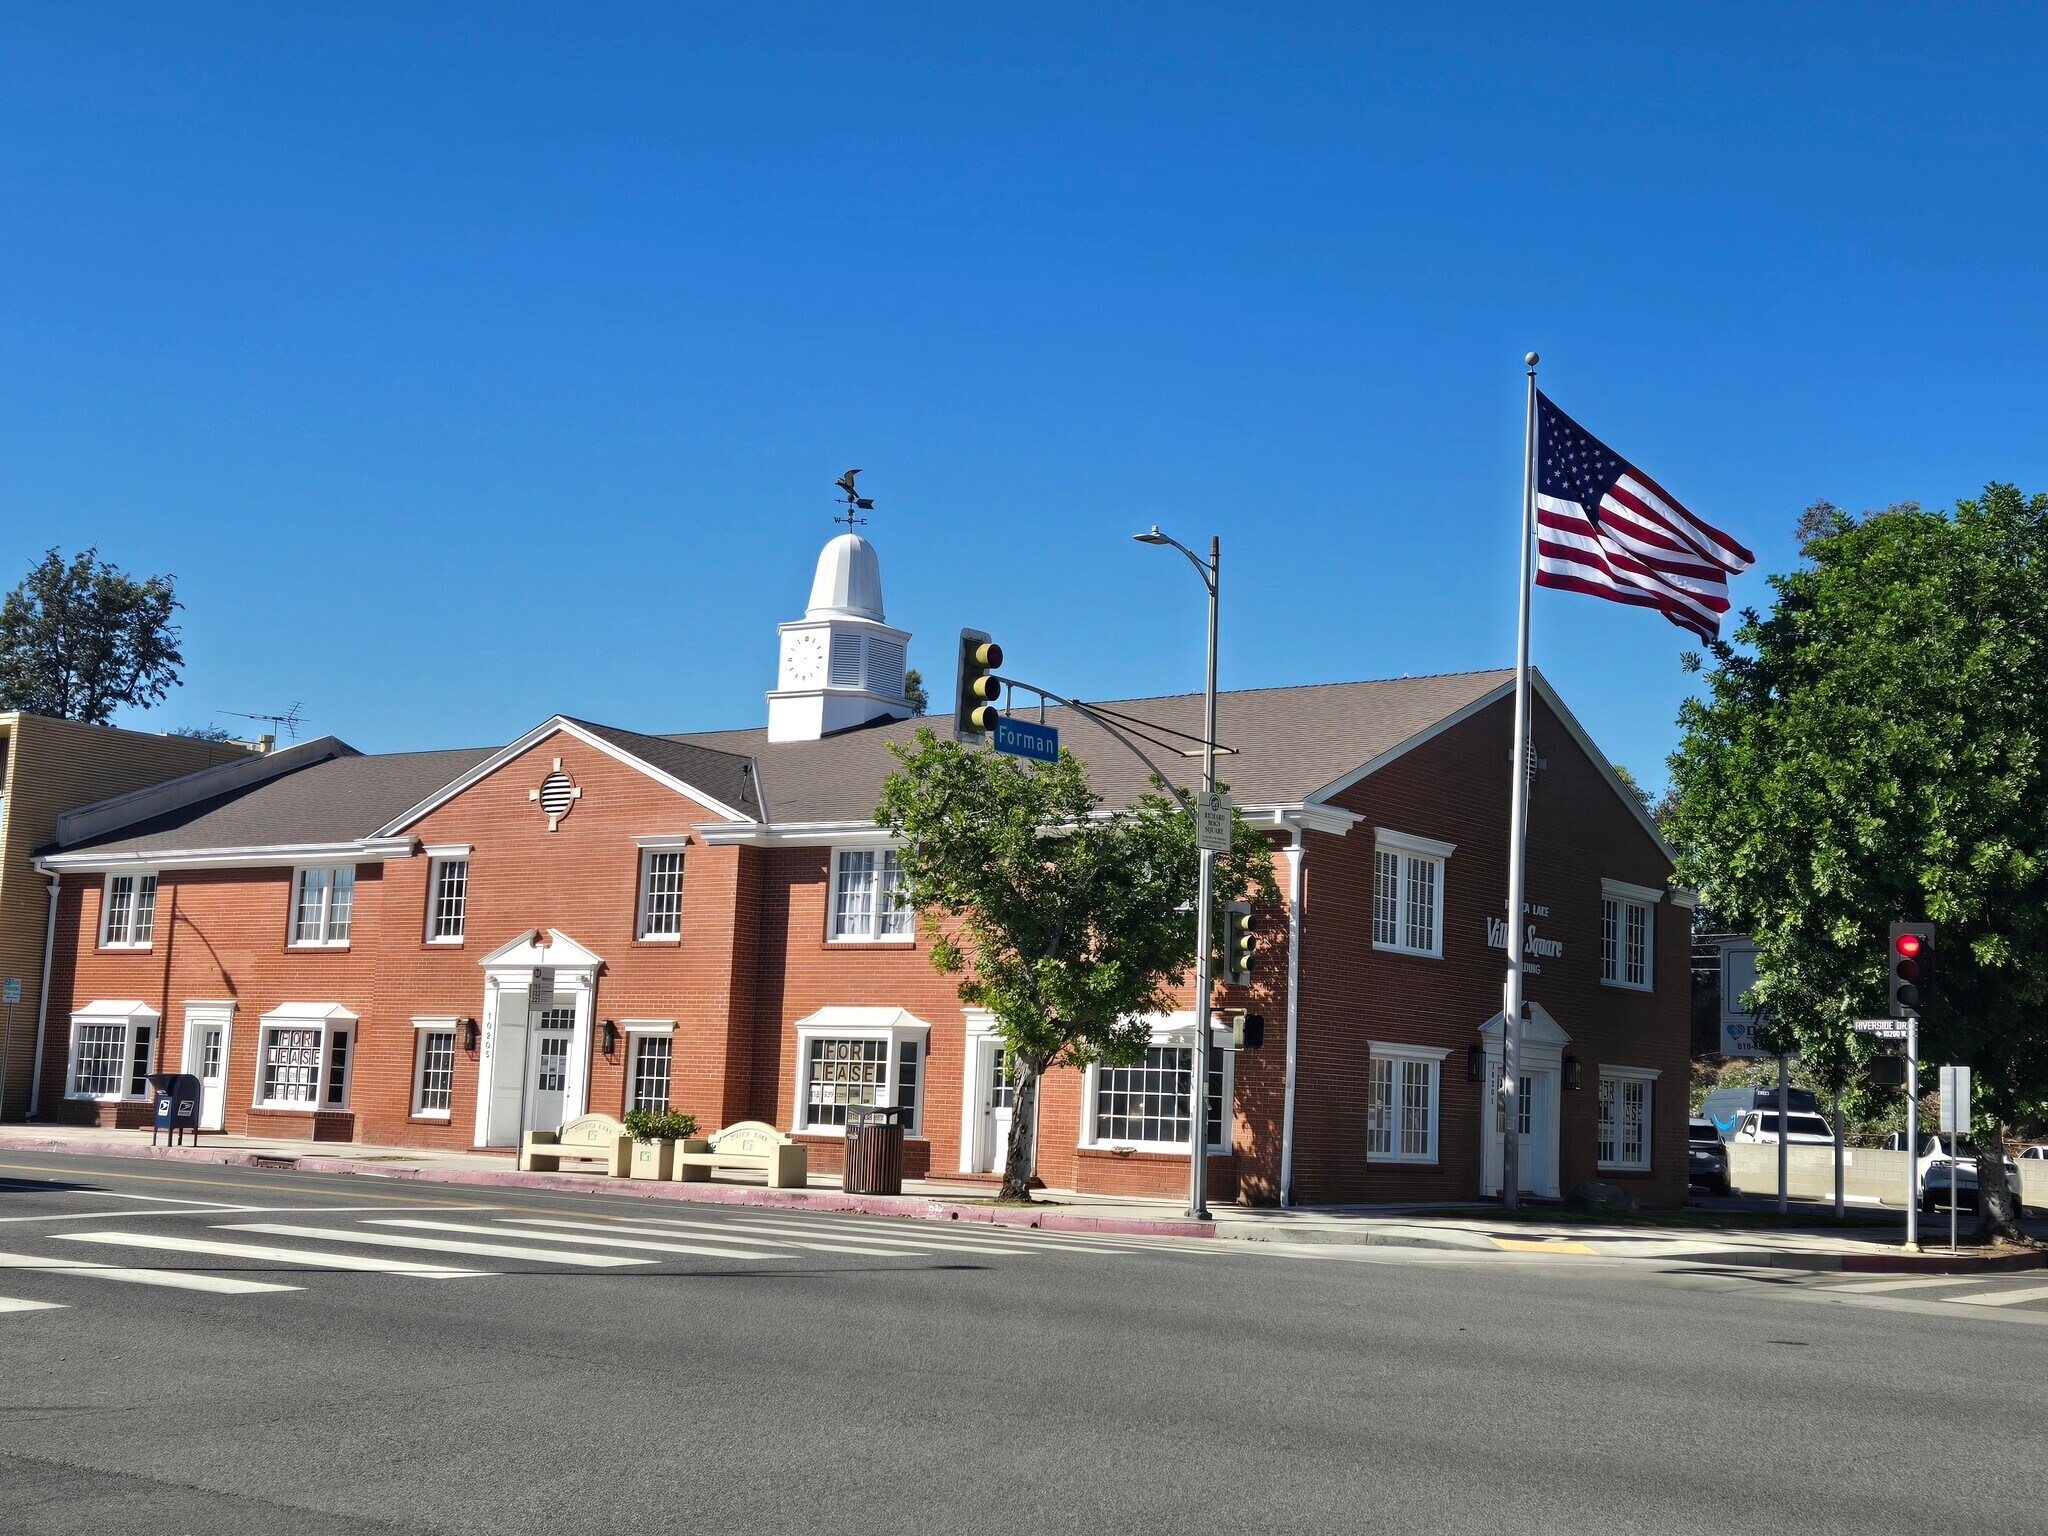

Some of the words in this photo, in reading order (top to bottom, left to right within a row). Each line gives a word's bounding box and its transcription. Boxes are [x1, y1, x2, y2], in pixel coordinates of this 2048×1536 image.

[999, 725, 1053, 753] Forman
[1204, 826, 1224, 835] SQUARE
[1532, 904, 1550, 917] LAKE
[1524, 924, 1563, 958] Square
[1855, 1021, 1894, 1030] RIVERSIDE
[281, 1031, 311, 1046] FOR
[268, 1048, 321, 1066] LEASE
[826, 1042, 862, 1060] FOR
[812, 1064, 874, 1082] LEASE
